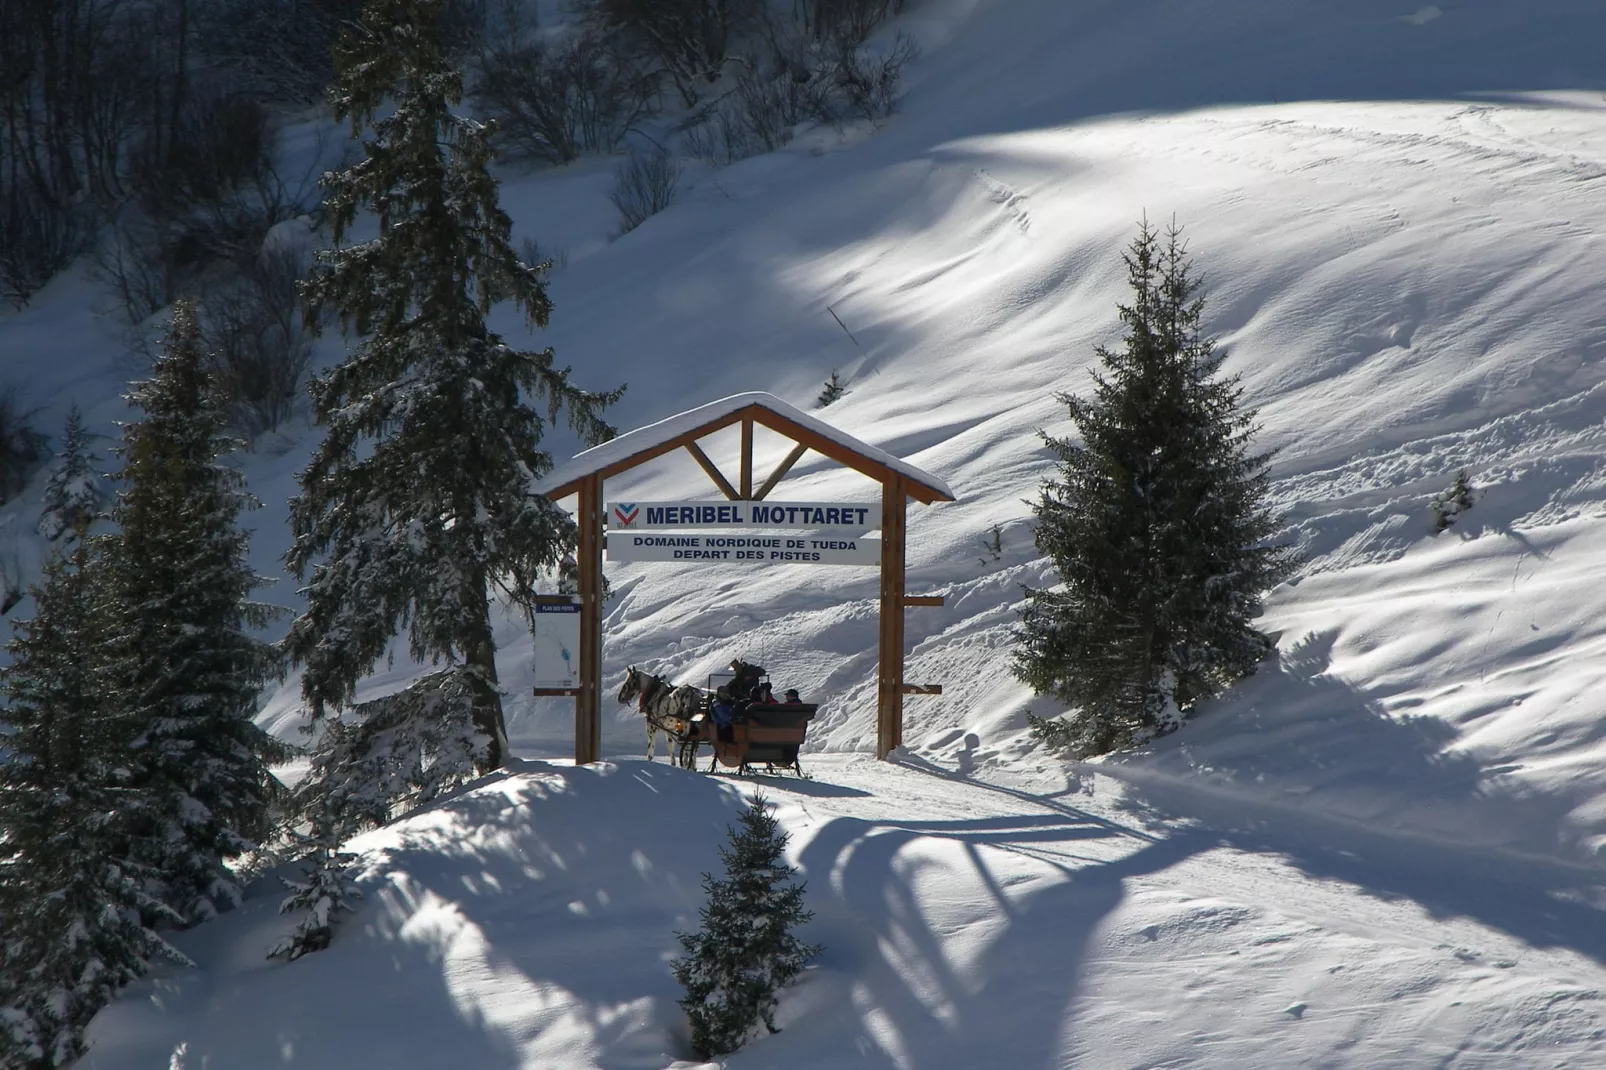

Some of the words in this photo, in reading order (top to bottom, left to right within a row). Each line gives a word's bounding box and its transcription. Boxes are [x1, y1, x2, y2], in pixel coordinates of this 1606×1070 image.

[647, 506, 743, 524] MERIBEL
[752, 506, 868, 525] MOTTARET
[633, 537, 700, 547] DOMAINE
[706, 538, 781, 549] NORDIQUE
[786, 539, 805, 549] DE
[812, 540, 856, 551] TUEDA
[674, 550, 730, 559] DEPART
[736, 550, 765, 560] DES
[771, 551, 820, 561] PISTES
